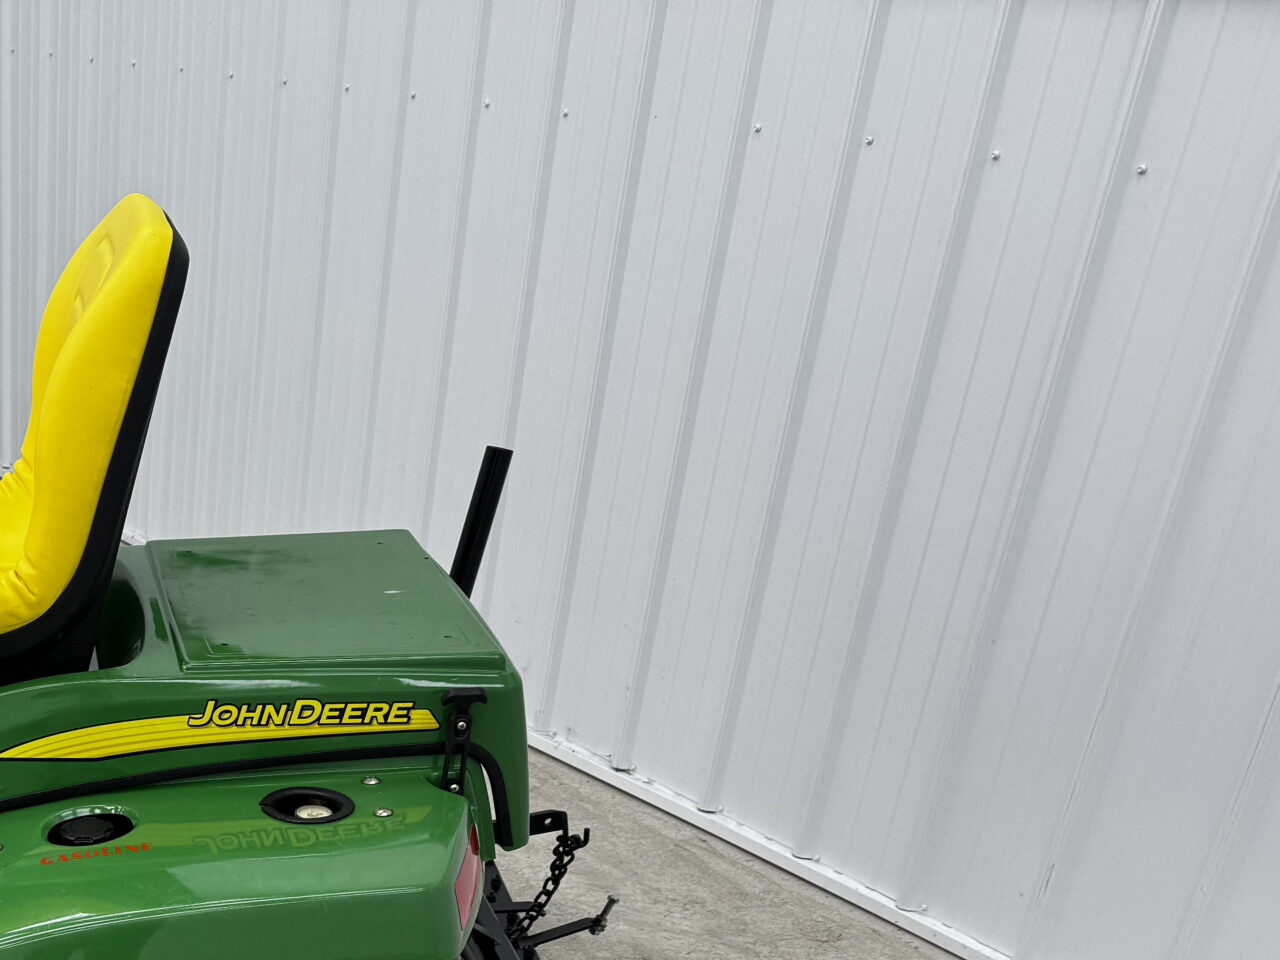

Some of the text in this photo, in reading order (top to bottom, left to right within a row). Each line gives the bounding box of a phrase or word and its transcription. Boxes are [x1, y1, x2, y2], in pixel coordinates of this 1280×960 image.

[188, 698, 415, 728] JOHN DEERE
[40, 842, 155, 866] GASOLINE
